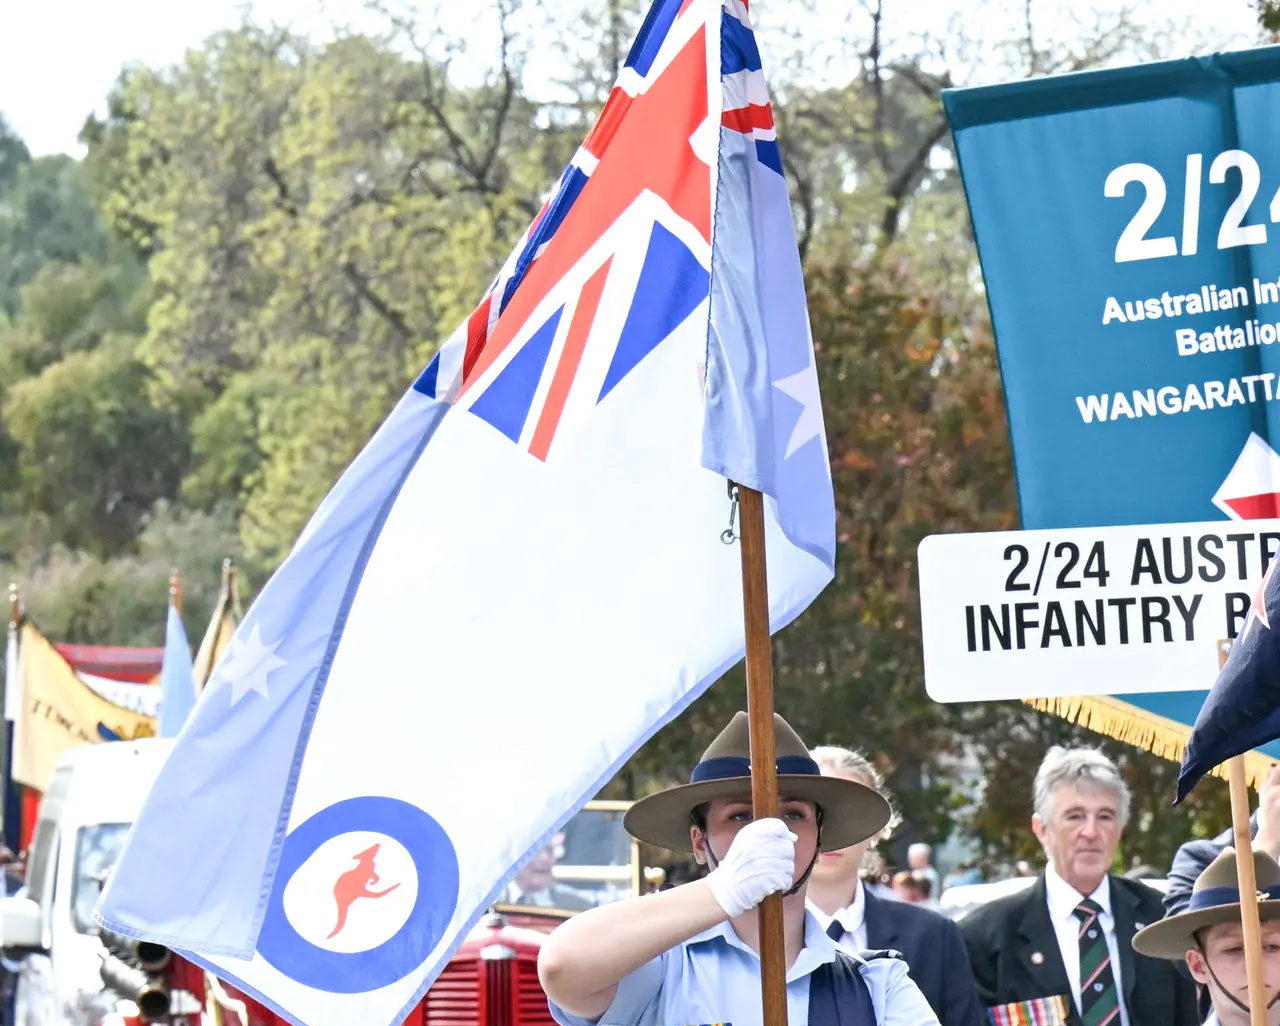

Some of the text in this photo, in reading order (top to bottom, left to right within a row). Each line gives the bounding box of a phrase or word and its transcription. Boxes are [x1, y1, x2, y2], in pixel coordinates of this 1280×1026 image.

[1102, 284, 1250, 325] Australian
[1003, 540, 1110, 596] 2/24
[965, 594, 1204, 652] INFANTRY
